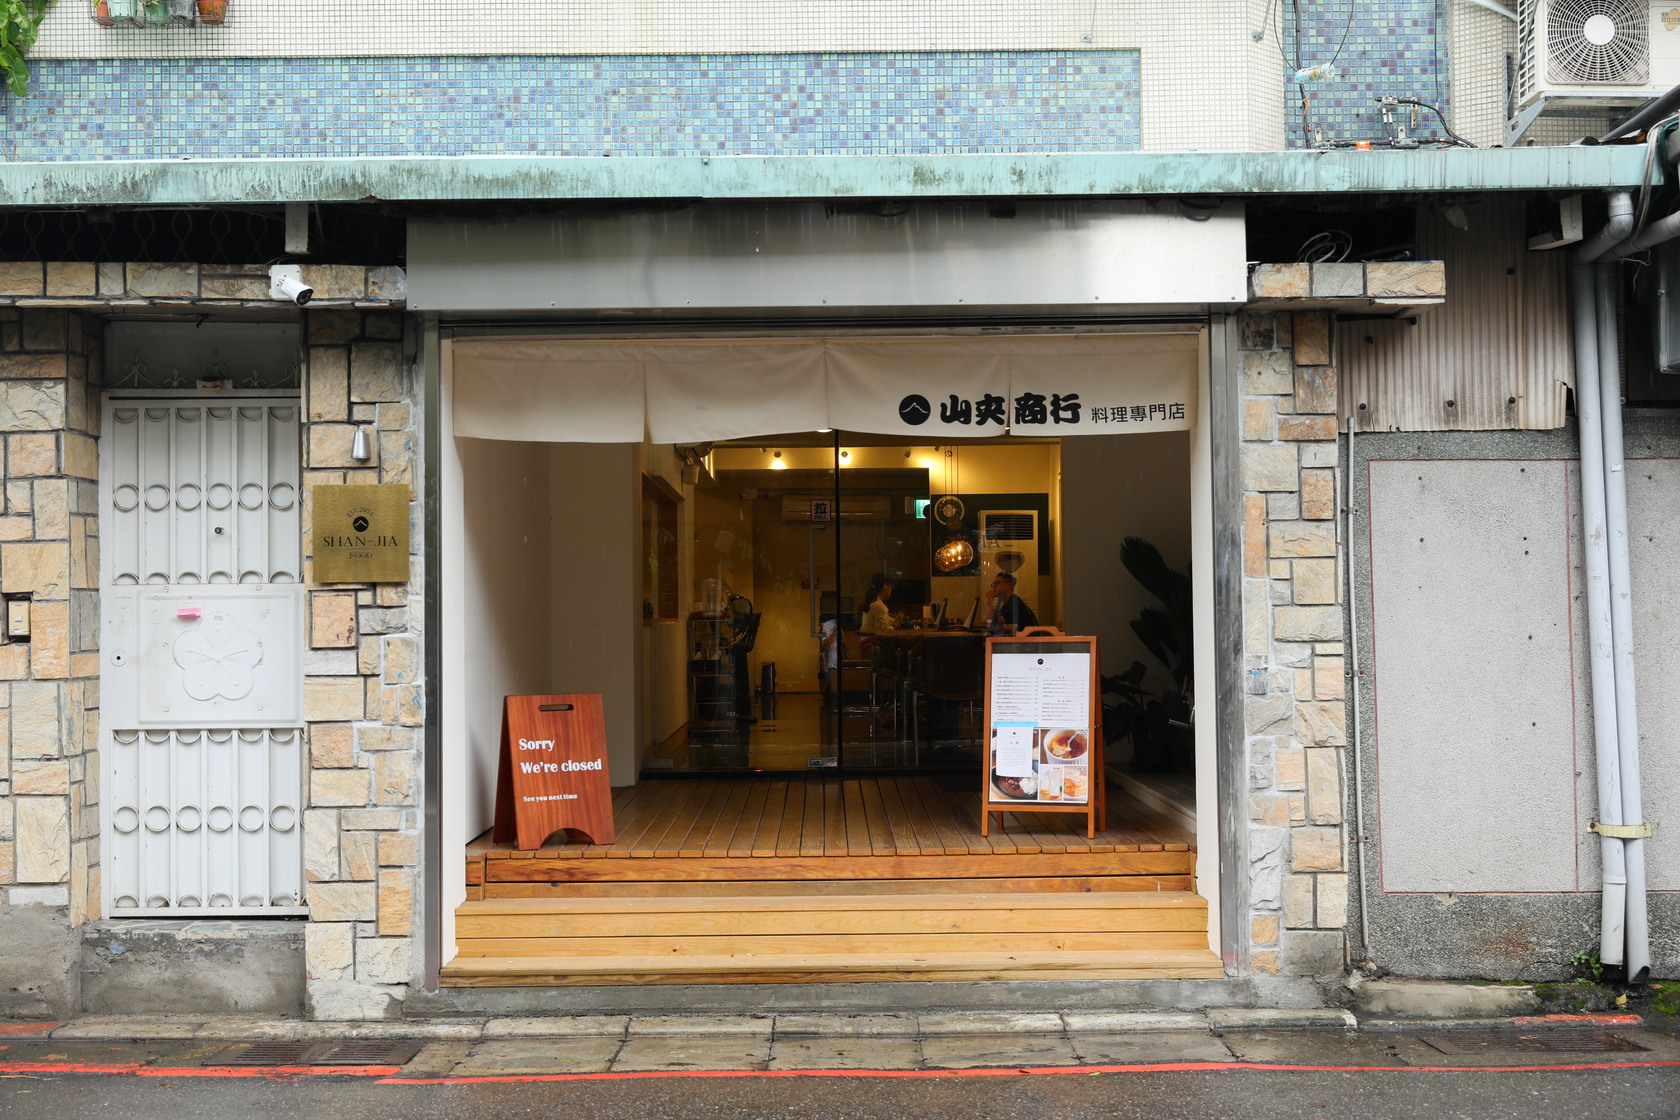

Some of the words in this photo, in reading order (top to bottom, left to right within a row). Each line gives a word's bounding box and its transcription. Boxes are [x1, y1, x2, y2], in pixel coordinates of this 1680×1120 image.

[1091, 402, 1185, 424] 料理專門店
[814, 502, 828, 515] 拉
[322, 535, 398, 547] SHAN-JIA
[349, 552, 373, 560] FOOD
[518, 738, 555, 752] Sorry
[520, 761, 558, 774] We're
[561, 758, 602, 772] closed
[536, 795, 548, 803] you
